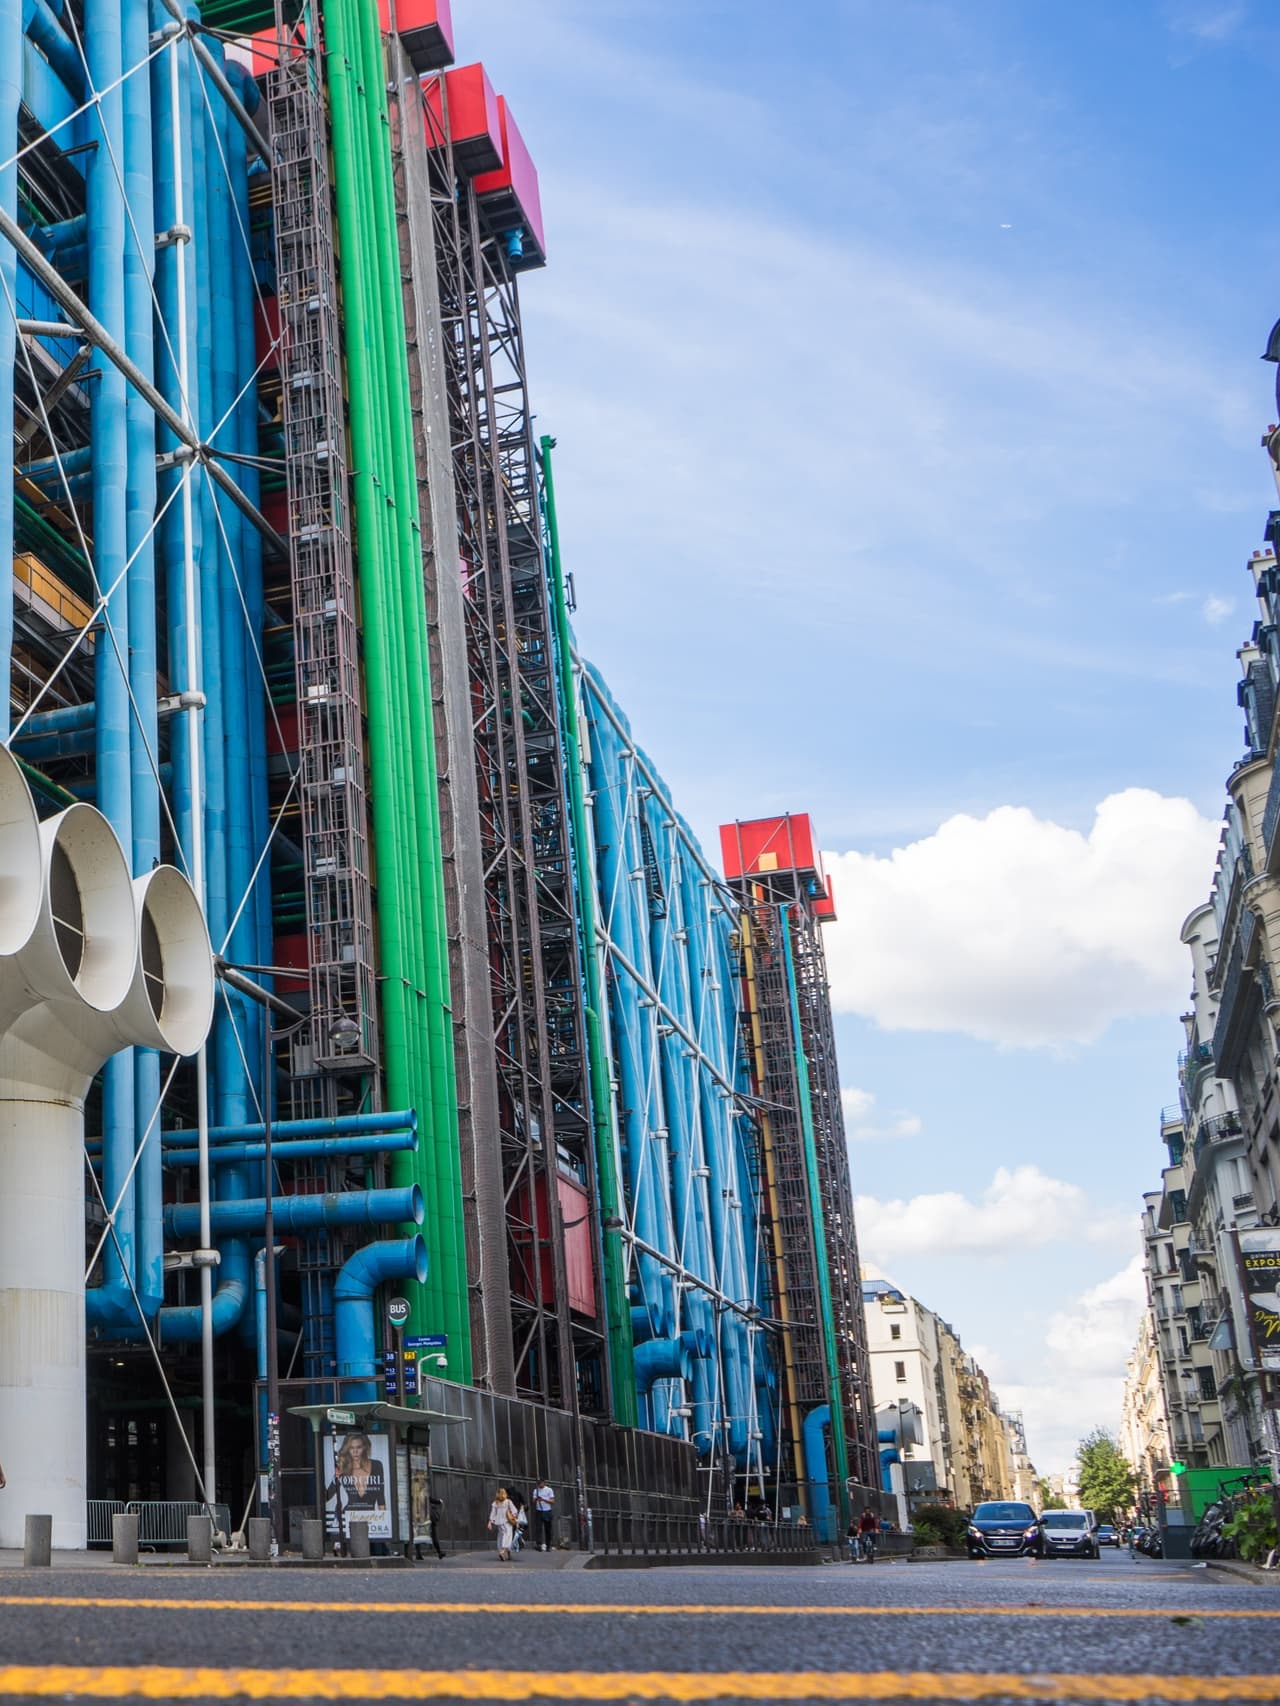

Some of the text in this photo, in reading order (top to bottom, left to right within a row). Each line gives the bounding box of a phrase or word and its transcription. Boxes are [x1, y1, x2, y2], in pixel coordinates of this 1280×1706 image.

[1245, 1258, 1280, 1268] EXPOS
[389, 1303, 407, 1314] BUS
[385, 1352, 395, 1360] 38
